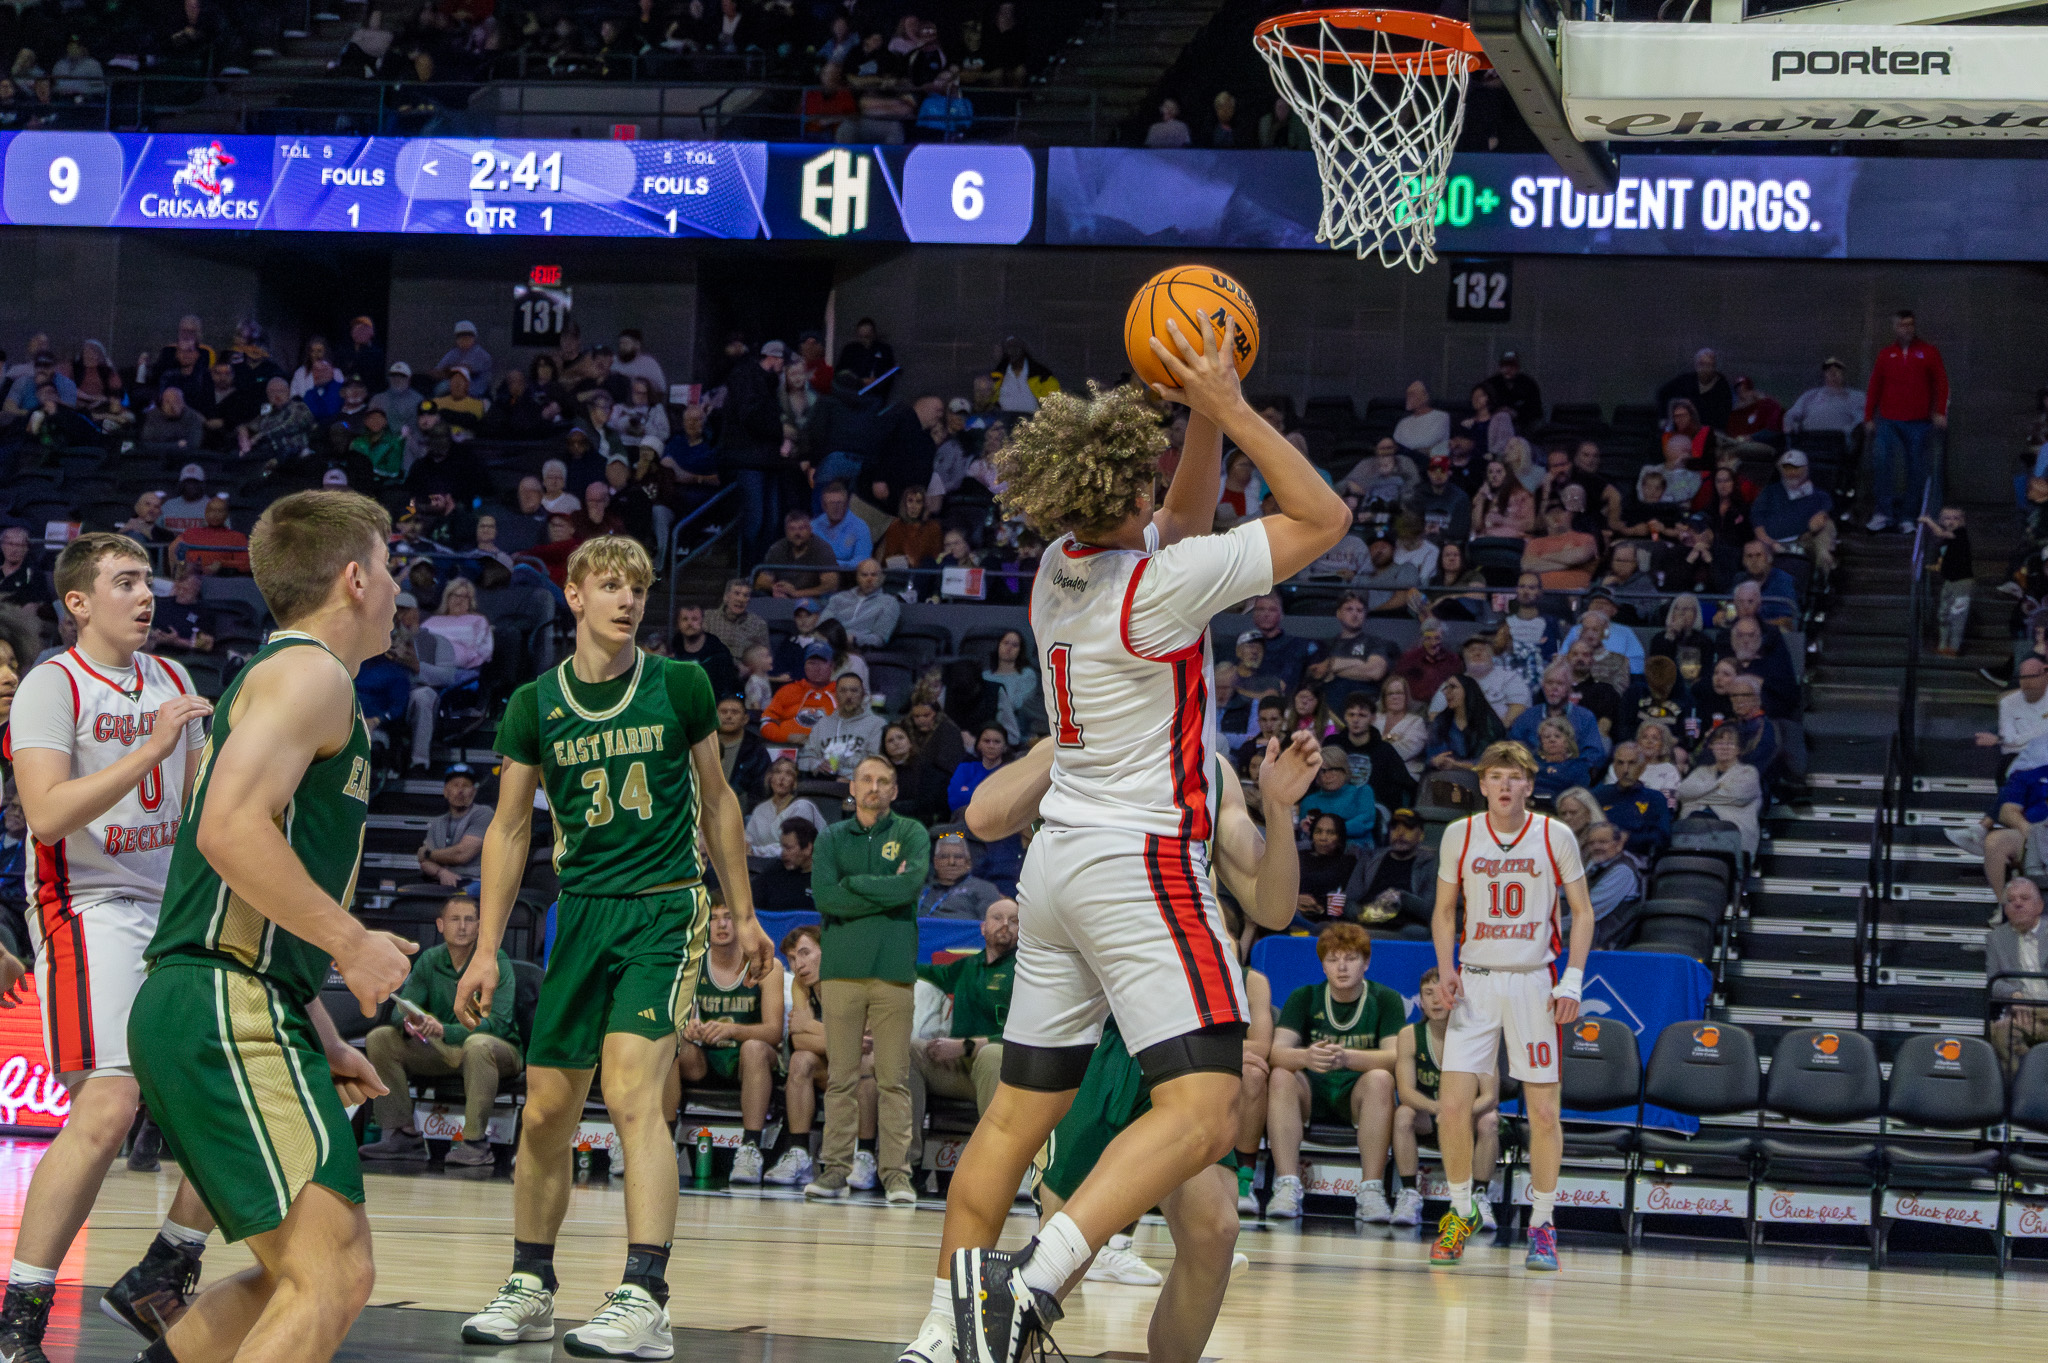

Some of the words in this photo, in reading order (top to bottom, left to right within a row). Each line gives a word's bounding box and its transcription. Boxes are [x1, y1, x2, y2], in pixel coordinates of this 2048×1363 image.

[48, 156, 80, 204] 9
[321, 167, 386, 187] FOULS
[468, 150, 563, 192] 2:41
[643, 176, 709, 196] FOULS
[139, 193, 260, 220] CRUSADERS
[950, 170, 986, 221] 6
[1509, 175, 1695, 230] STUDENT
[1701, 179, 1822, 233] ORGS.
[347, 203, 360, 229] 1
[465, 207, 517, 230] QTR
[540, 206, 553, 232] 1
[665, 208, 678, 234] 1
[1452, 271, 1508, 310] 132
[520, 300, 565, 335] 131
[1209, 306, 1252, 363] NAA
[1047, 641, 1085, 749] 1
[553, 734, 600, 767] EAST
[602, 724, 664, 757] HARDY
[581, 762, 652, 827] 34
[1471, 857, 1542, 877] GREATER
[1488, 881, 1525, 918] 10
[1473, 921, 1542, 941] BECKLEY
[1526, 1041, 1552, 1069] 10
